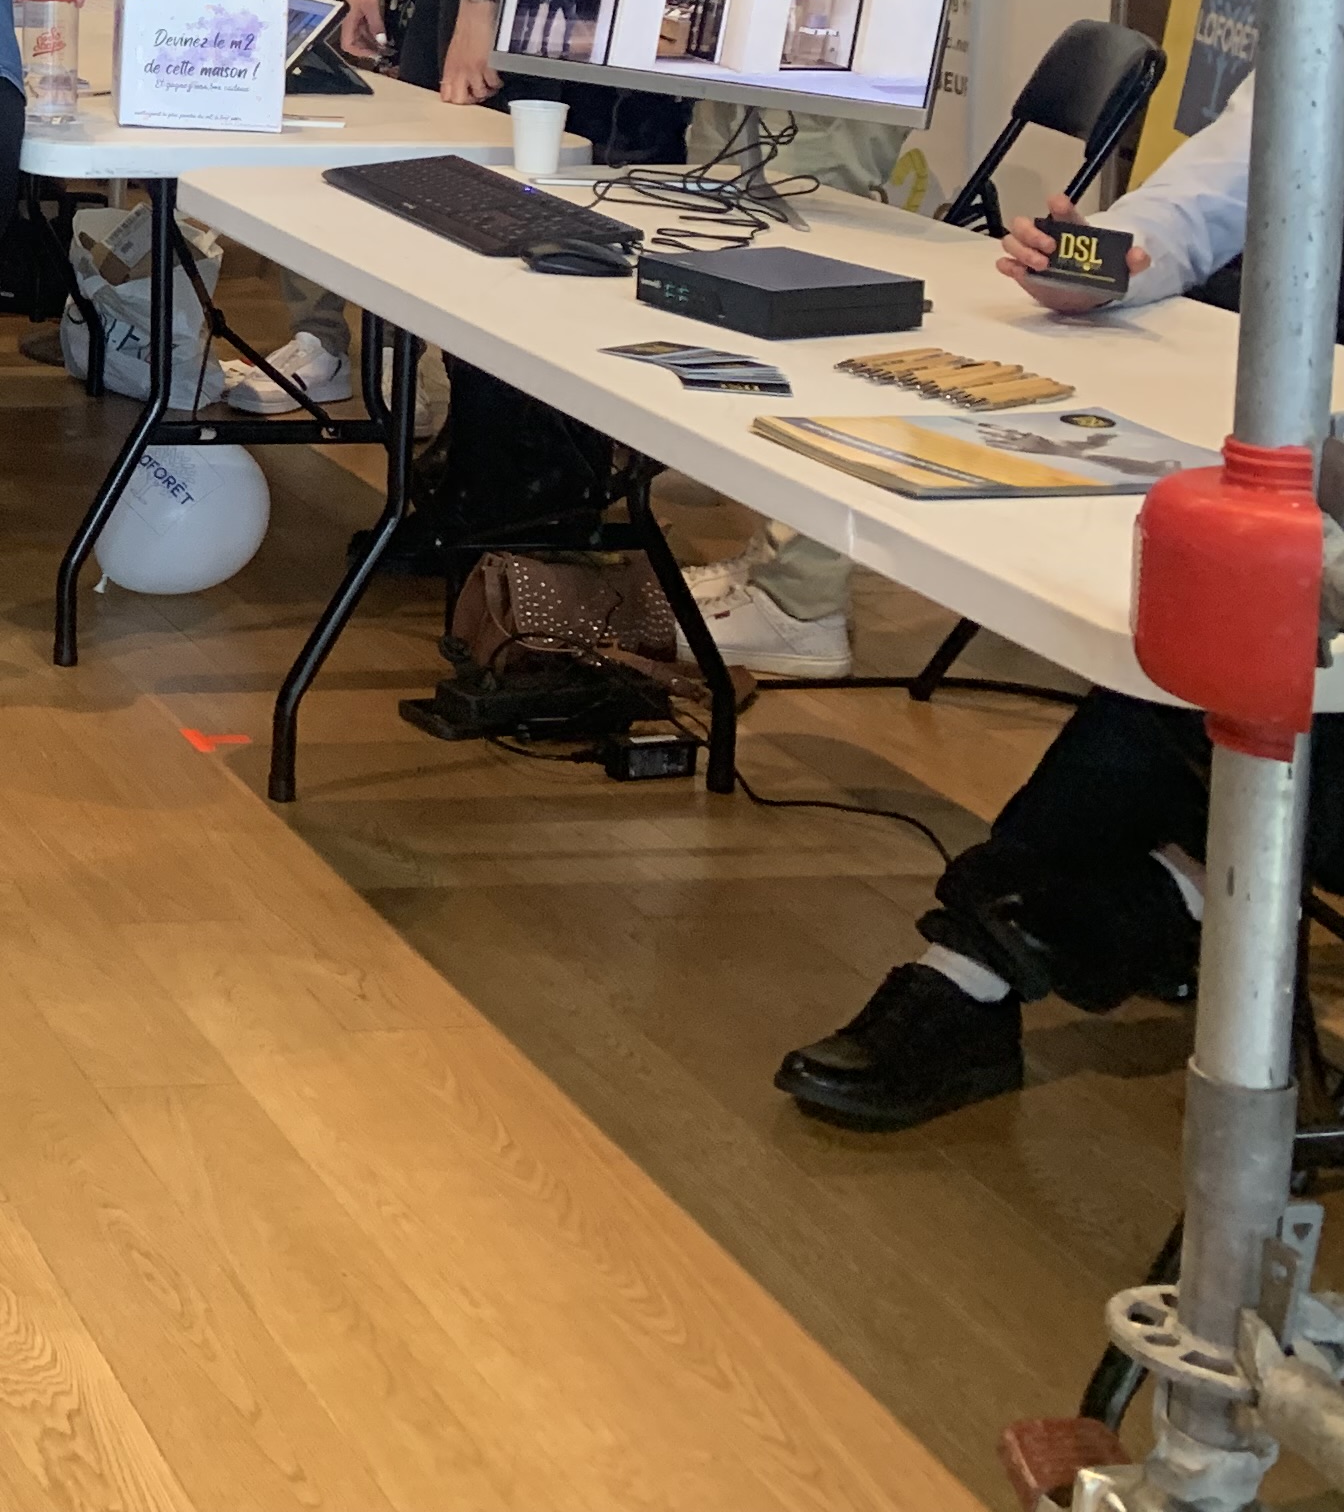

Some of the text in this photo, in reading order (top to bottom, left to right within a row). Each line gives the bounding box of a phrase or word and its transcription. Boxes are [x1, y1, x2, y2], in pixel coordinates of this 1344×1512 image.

[153, 28, 209, 48] Devinez
[213, 32, 225, 49] le
[144, 59, 161, 74] de
[165, 60, 195, 76] cette
[200, 65, 247, 79] maison
[1058, 232, 1103, 266] DSL
